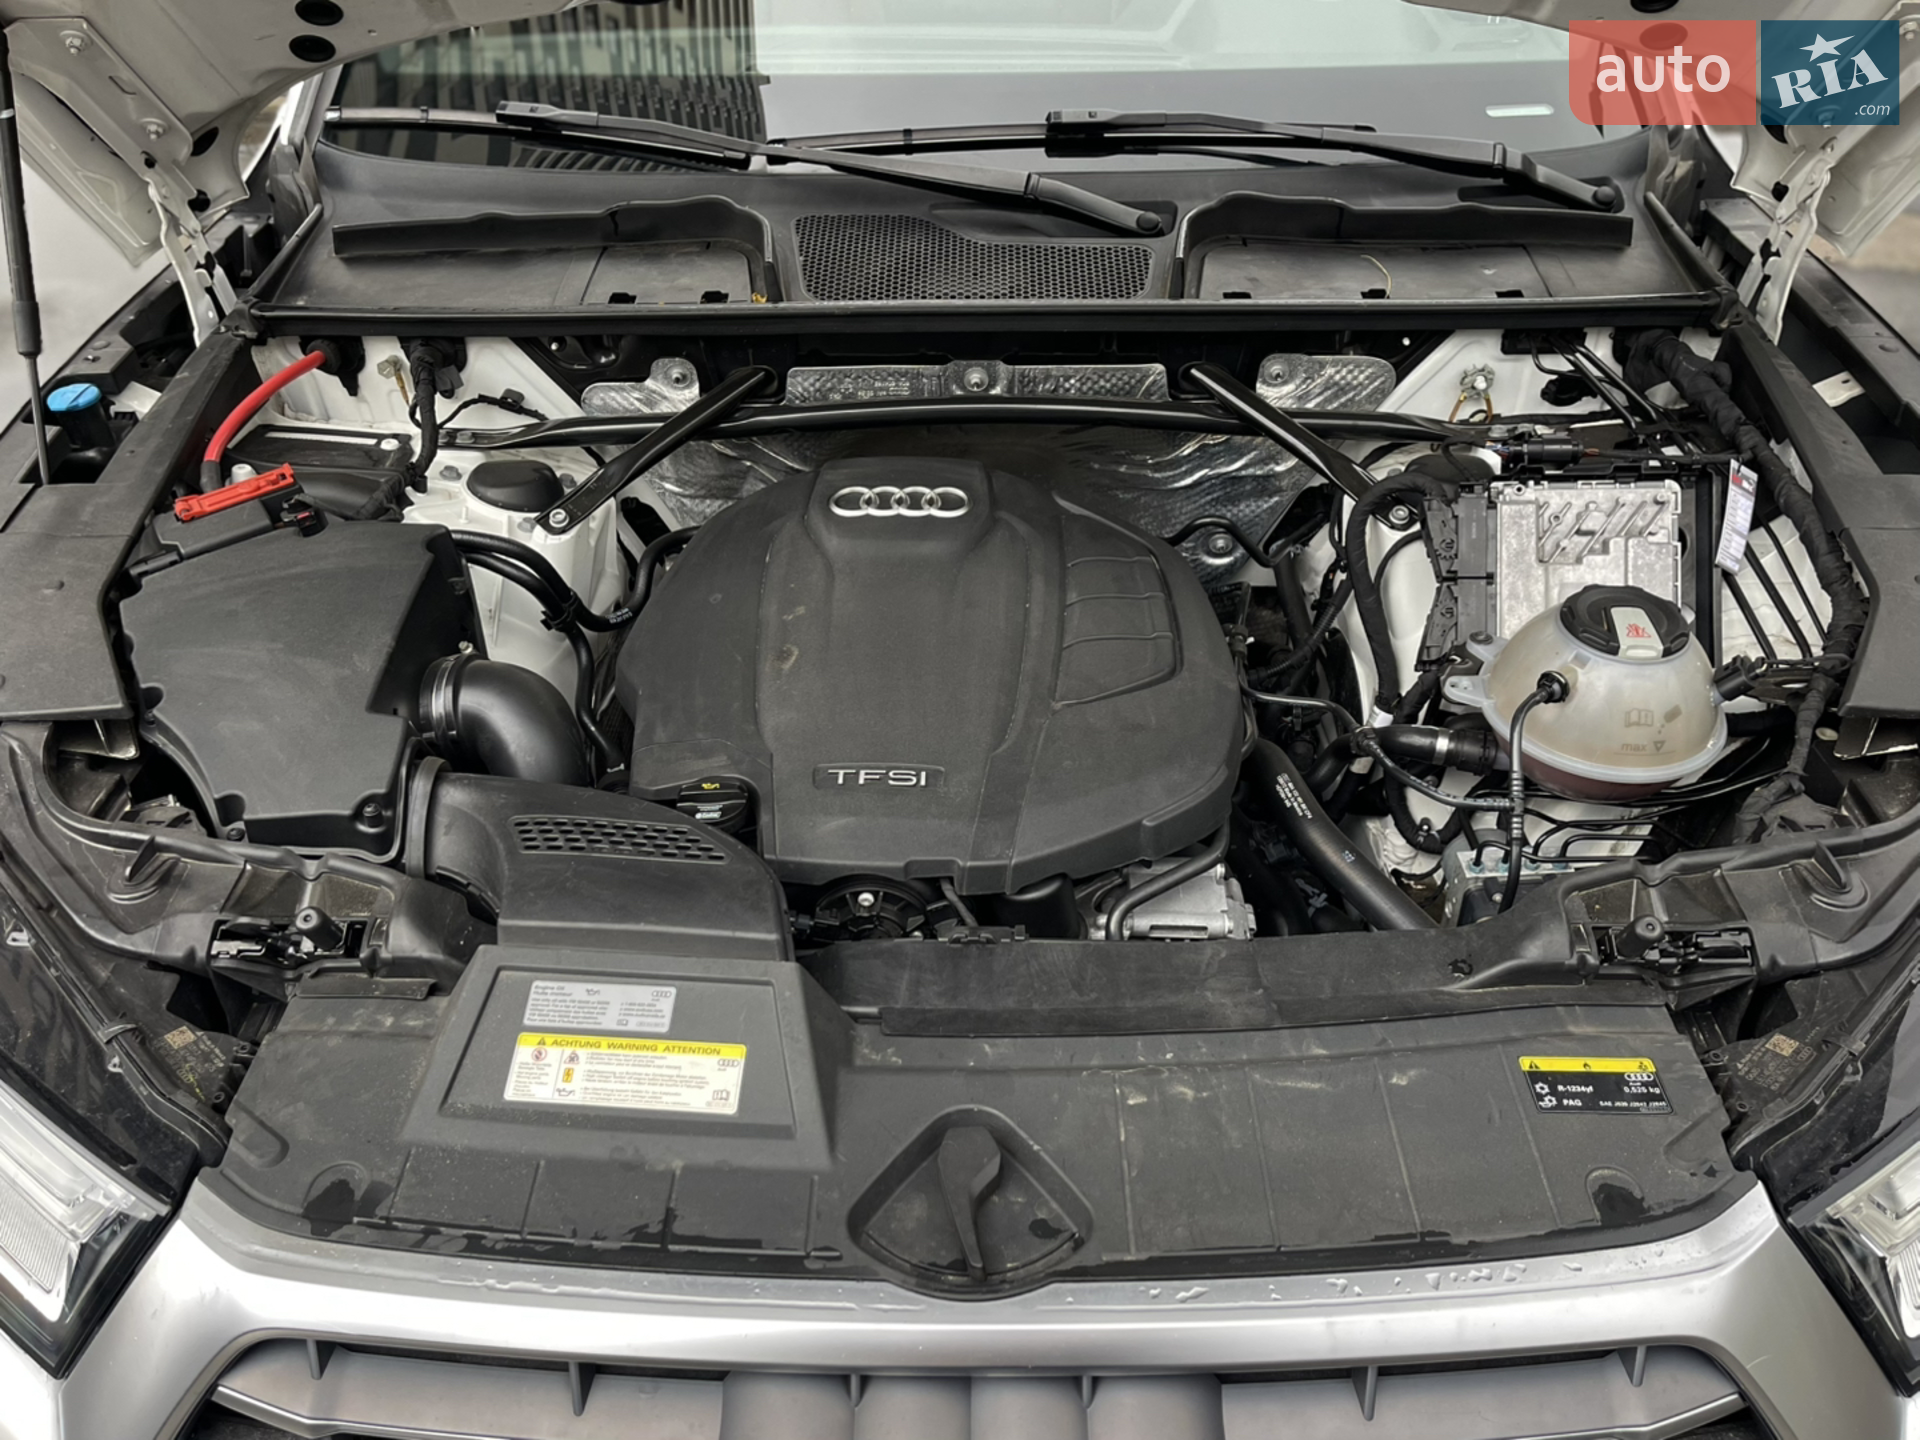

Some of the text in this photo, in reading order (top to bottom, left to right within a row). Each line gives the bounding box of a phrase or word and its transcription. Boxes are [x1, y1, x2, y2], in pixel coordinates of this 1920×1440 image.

[1621, 743, 1648, 752] max
[827, 769, 927, 787] TFSI
[551, 1038, 602, 1049] ACHTUNG
[607, 1041, 658, 1052] WARNING
[663, 1044, 721, 1056] ATTENTION
[1648, 1086, 1661, 1094] kg
[1562, 1098, 1583, 1107] PAG
